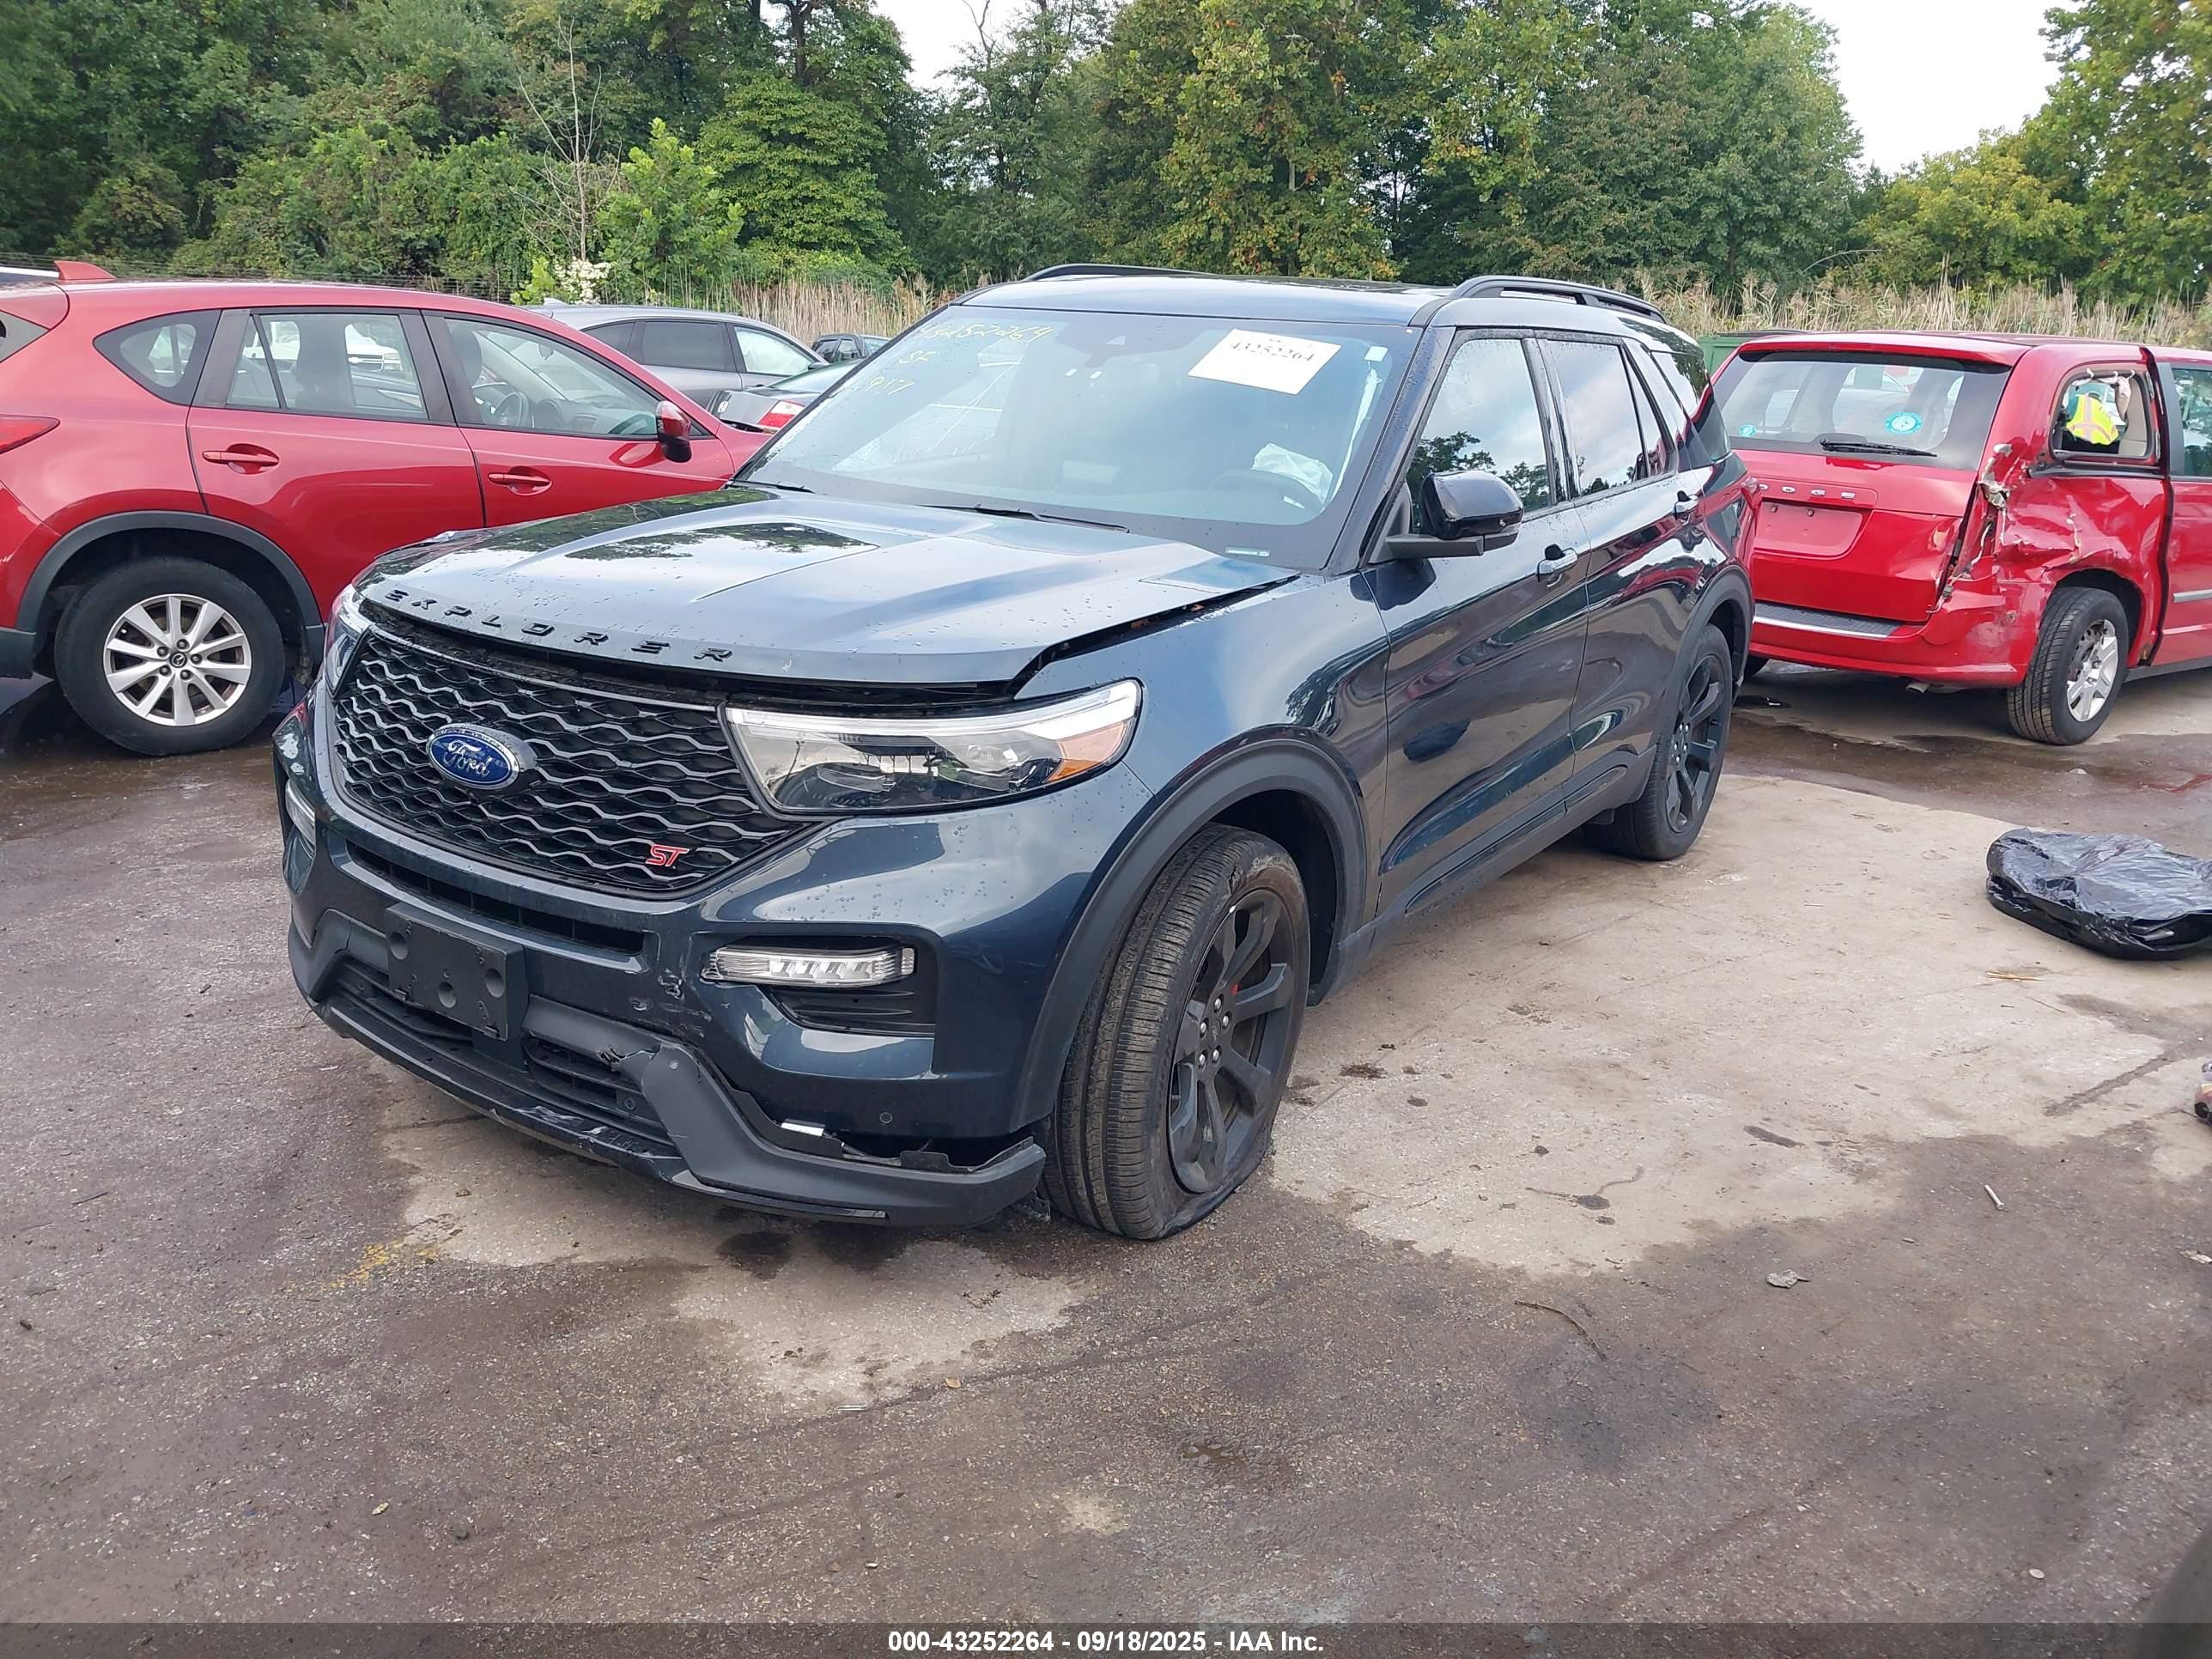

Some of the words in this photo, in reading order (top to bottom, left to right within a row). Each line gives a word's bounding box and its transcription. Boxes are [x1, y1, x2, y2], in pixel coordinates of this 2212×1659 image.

[384, 588, 733, 663] EXPLORER
[443, 739, 491, 776] Ford
[645, 844, 690, 867] ST
